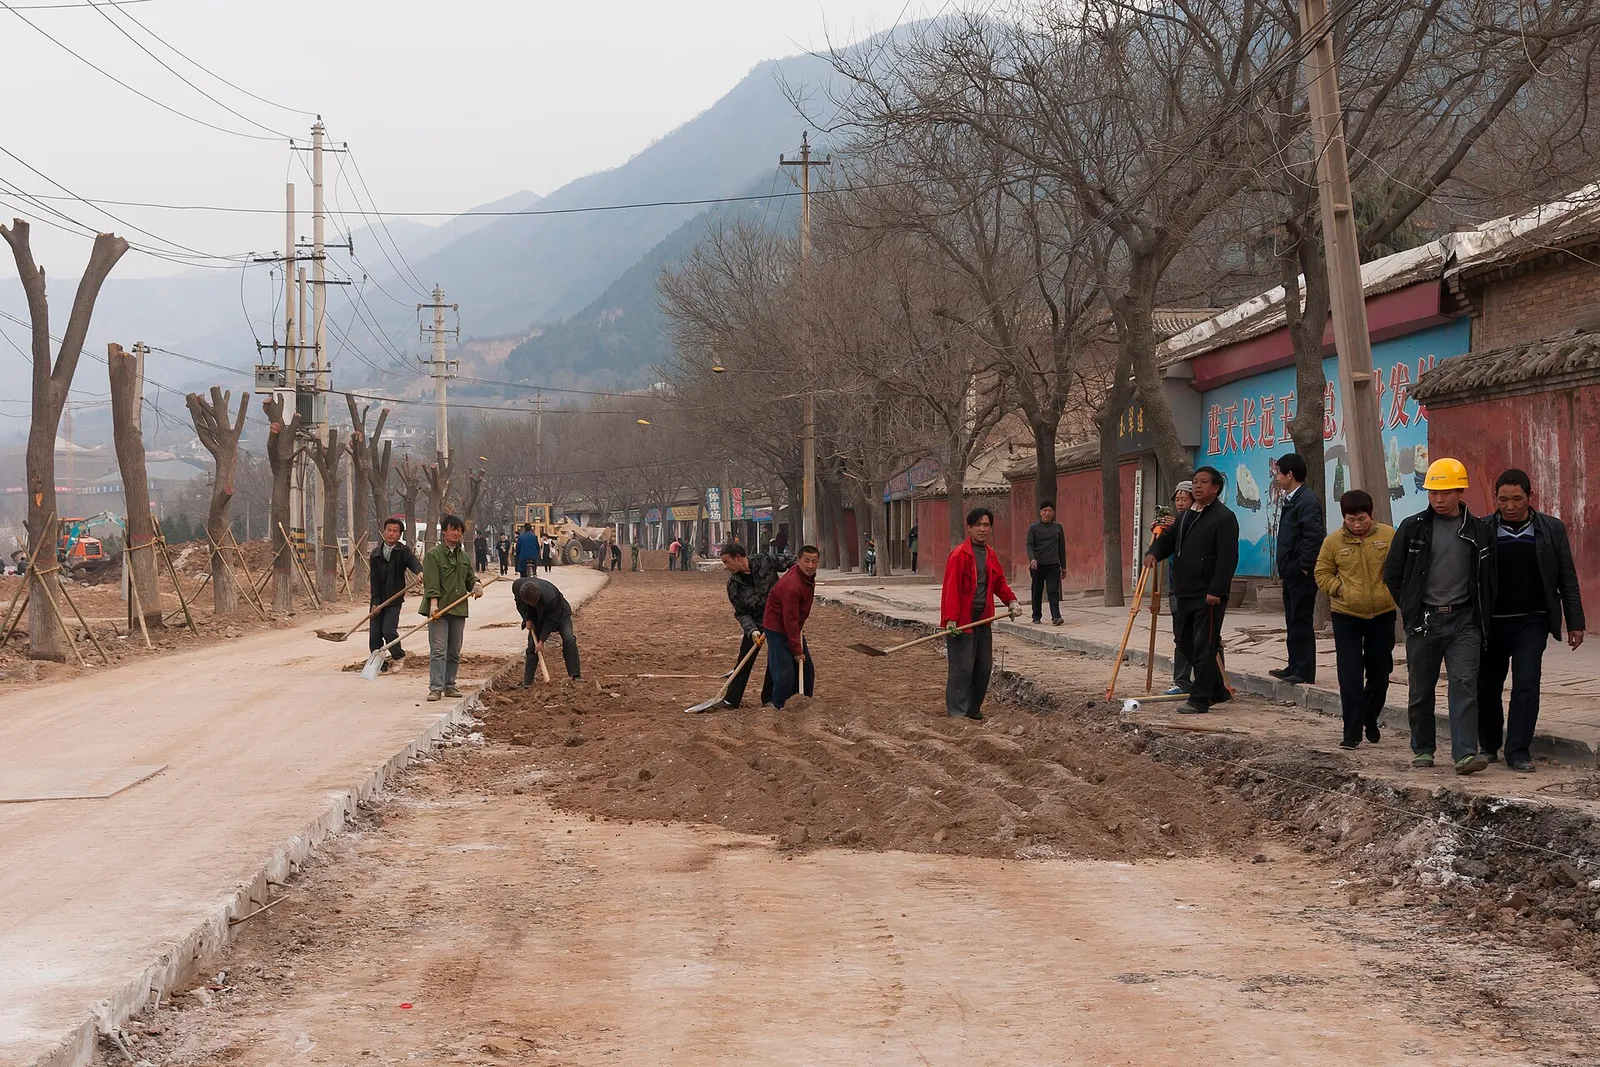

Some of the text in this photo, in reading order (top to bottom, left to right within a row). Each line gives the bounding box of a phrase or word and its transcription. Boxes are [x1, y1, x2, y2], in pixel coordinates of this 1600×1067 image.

[1207, 354, 1436, 456] 蓝天长远玉总发
